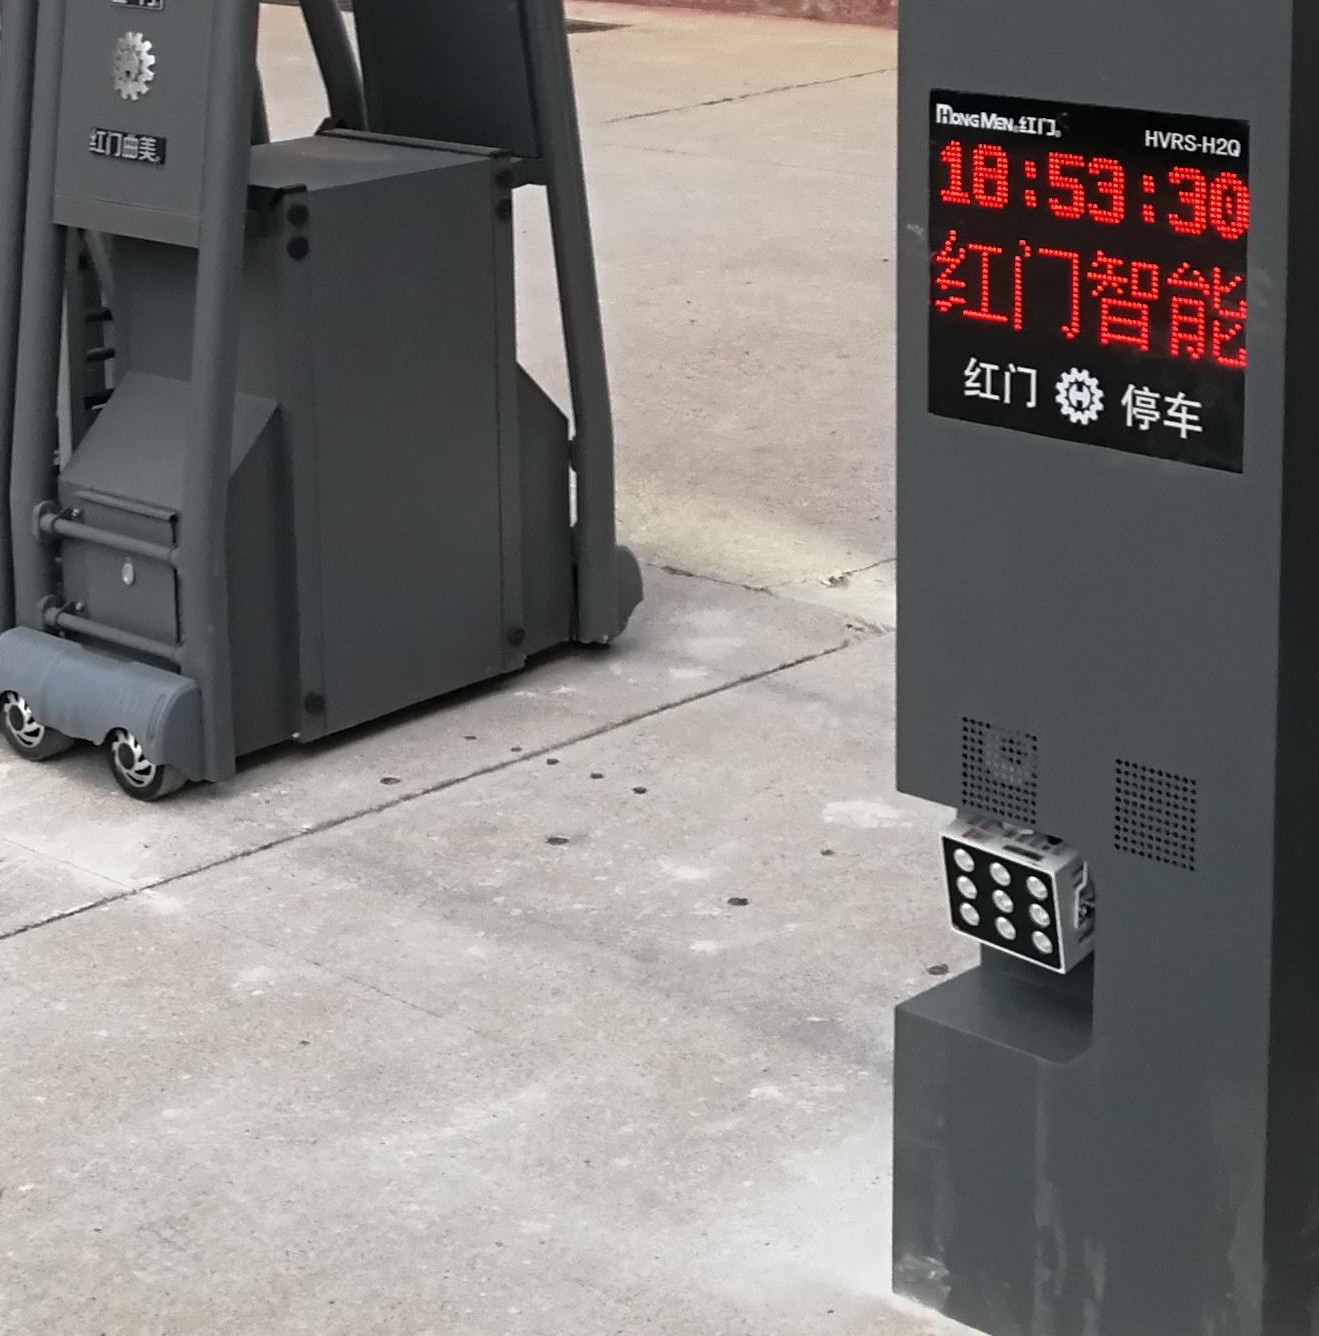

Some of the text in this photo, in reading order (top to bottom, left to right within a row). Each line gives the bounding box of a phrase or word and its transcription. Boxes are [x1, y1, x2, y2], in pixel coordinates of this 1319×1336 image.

[1144, 129, 1242, 158] HVRS-H2Q
[939, 139, 1250, 241] 18:53:30
[934, 229, 1248, 370] 红门智能
[963, 357, 1204, 440] 红门 停车
